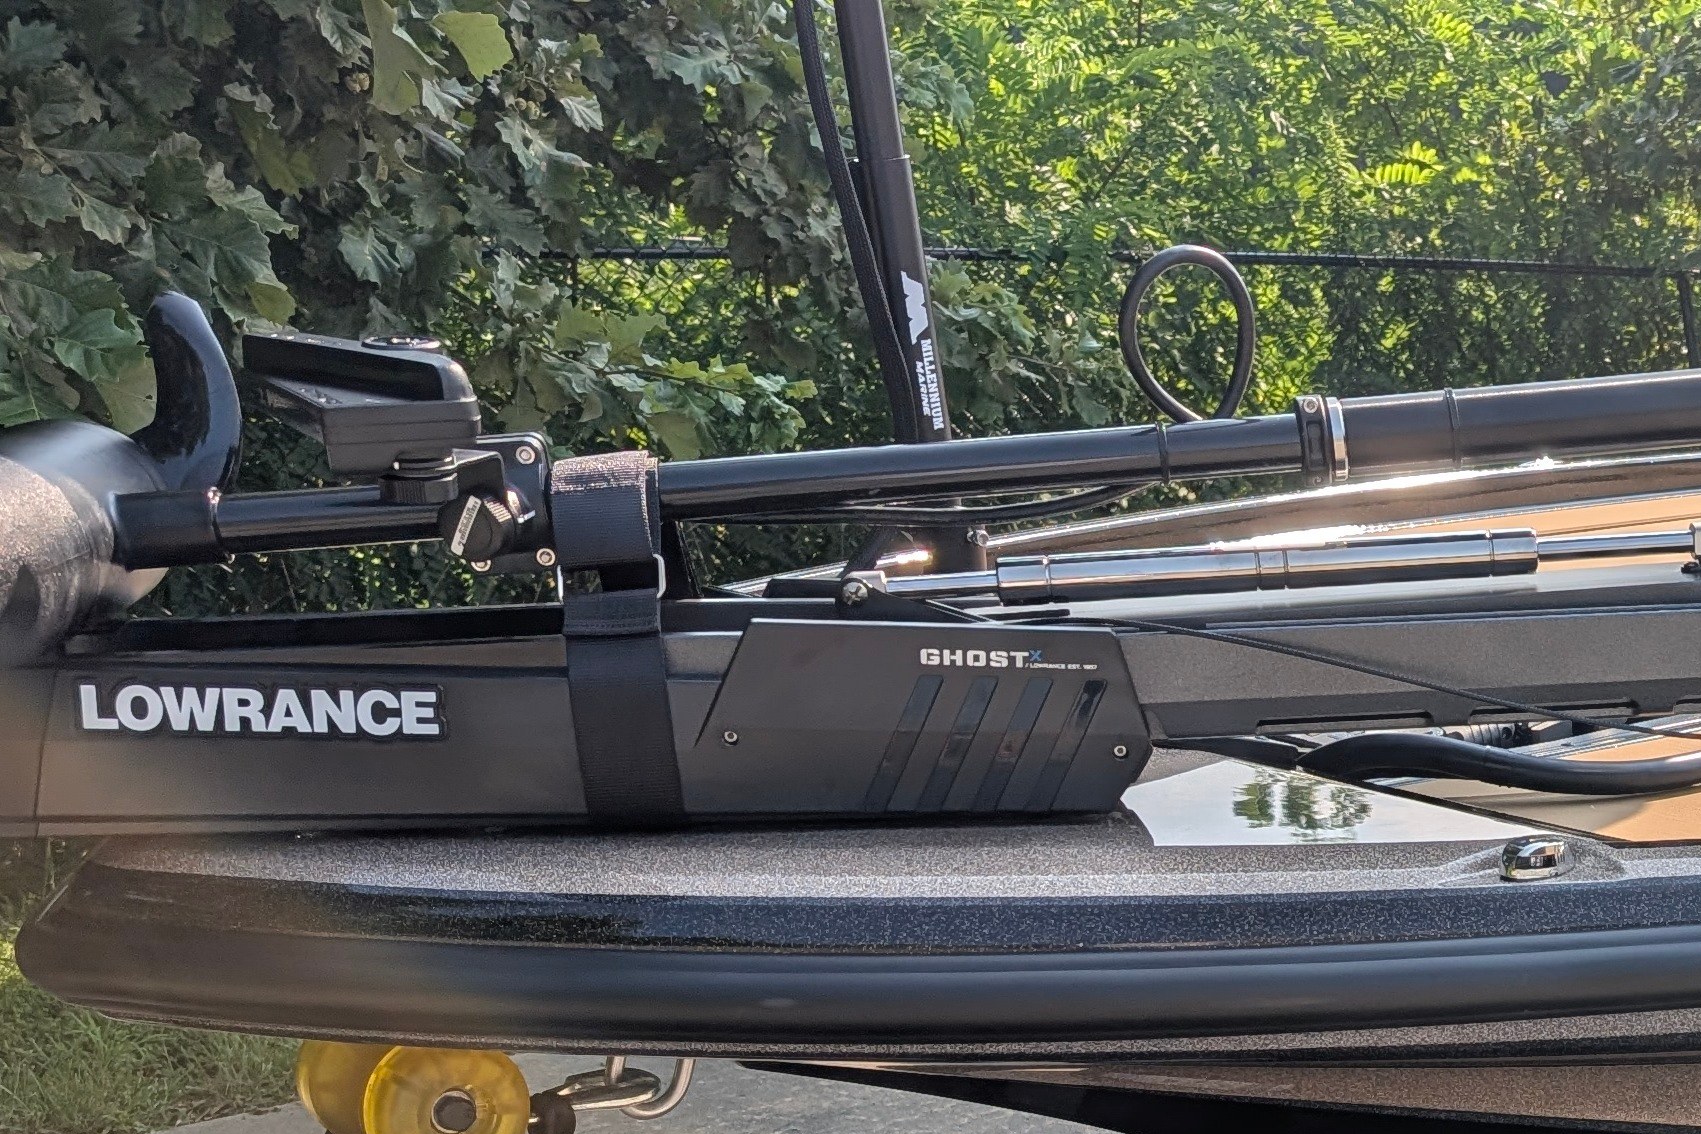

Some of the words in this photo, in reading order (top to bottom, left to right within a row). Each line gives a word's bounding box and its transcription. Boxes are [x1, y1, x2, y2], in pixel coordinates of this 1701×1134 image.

[915, 360, 931, 416] MARINE
[920, 338, 944, 430] MILLENNIUM
[919, 648, 1029, 668] GHOST
[79, 684, 440, 737] LOWRANCE
